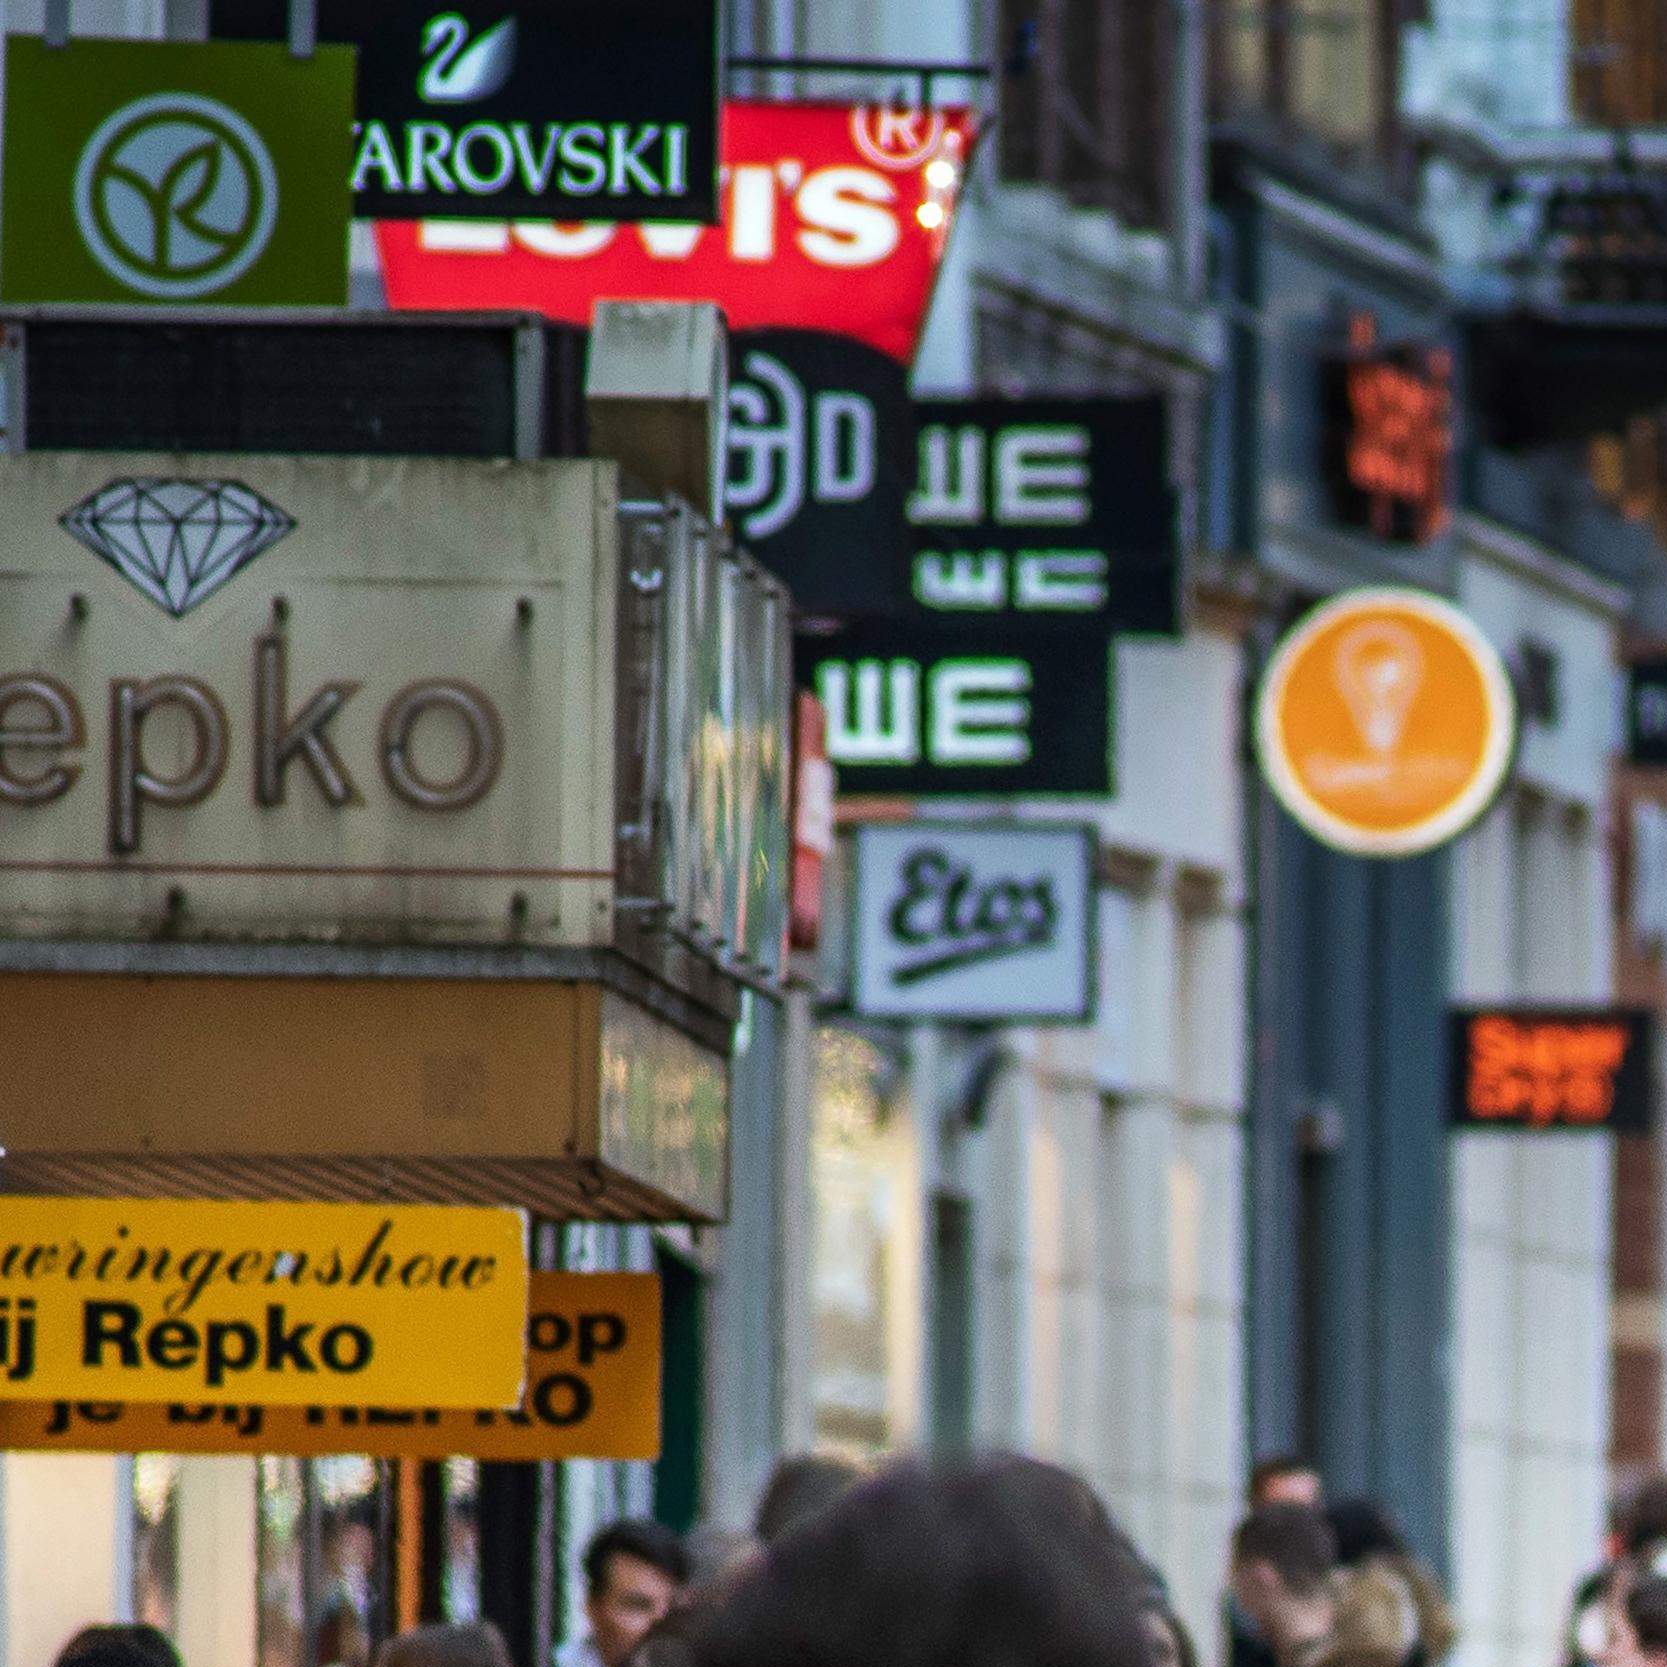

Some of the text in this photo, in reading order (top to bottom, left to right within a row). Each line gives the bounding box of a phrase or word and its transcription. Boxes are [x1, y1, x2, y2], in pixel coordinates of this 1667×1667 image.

[0, 632, 504, 854] epko
[815, 660, 1032, 766] WE
[890, 848, 1058, 952] Etos
[82, 1299, 374, 1388] Repko
